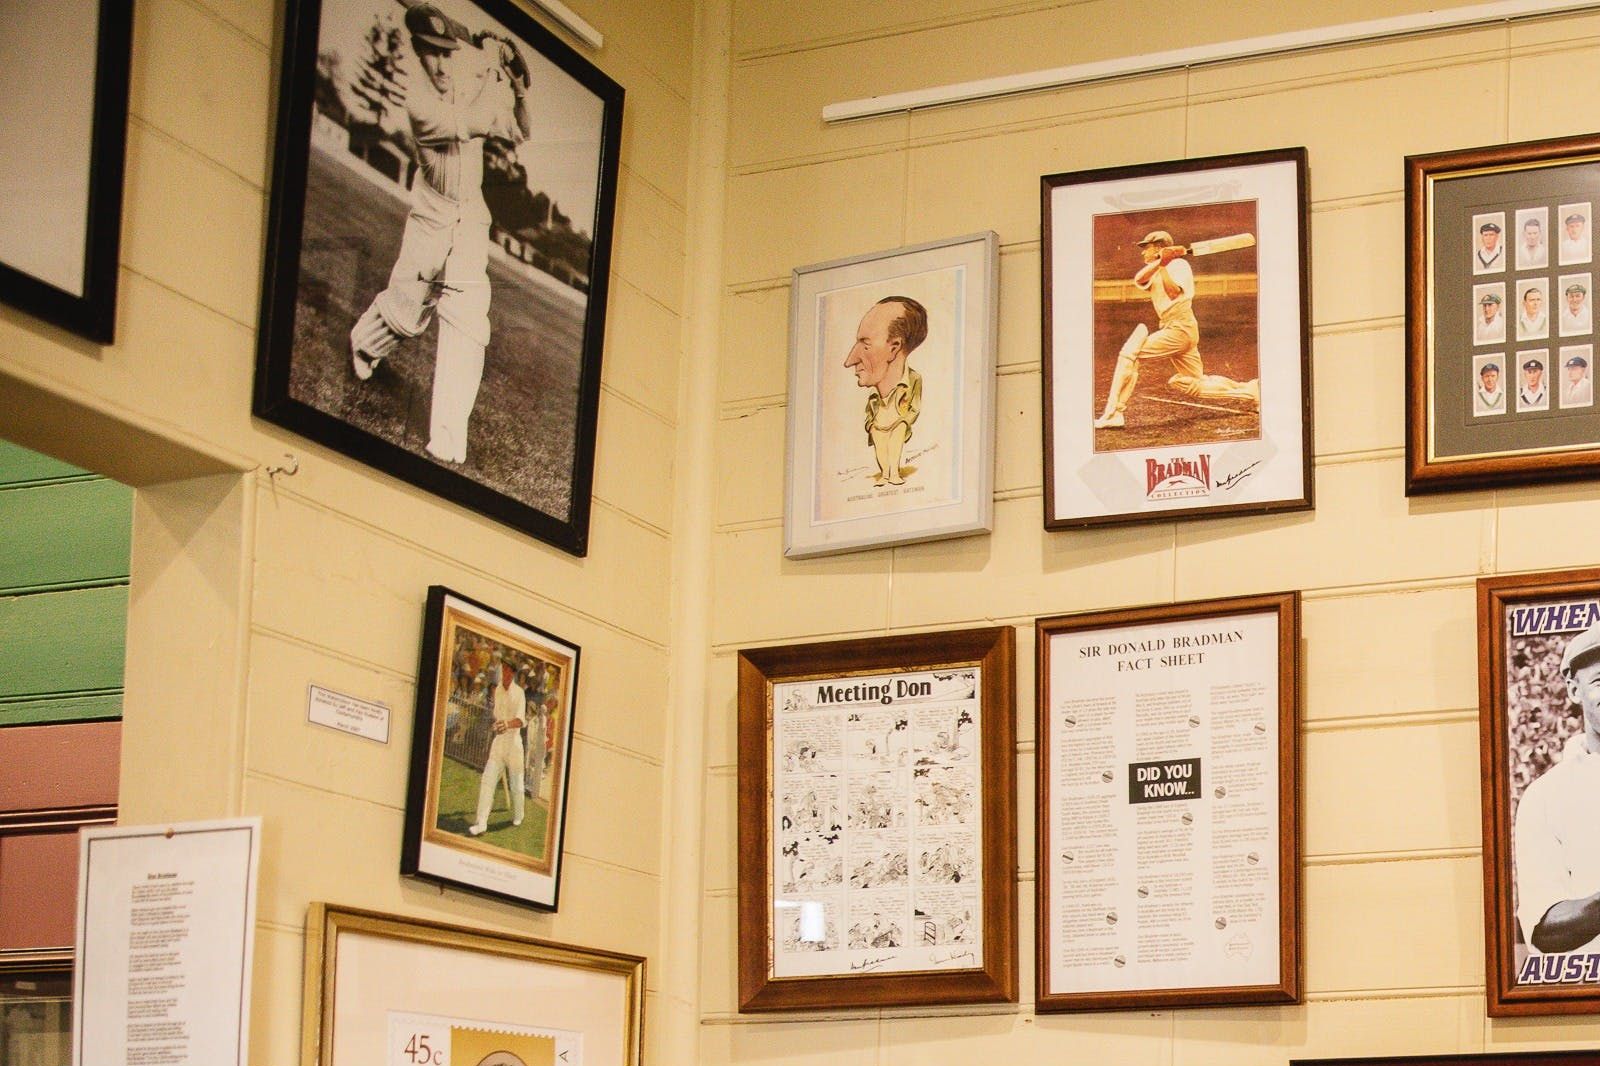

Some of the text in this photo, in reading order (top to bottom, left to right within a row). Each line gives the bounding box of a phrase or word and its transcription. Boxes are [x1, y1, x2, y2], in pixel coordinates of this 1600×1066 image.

[1145, 454, 1211, 496] BRADMAN
[1079, 630, 1244, 659] SIR DONALD BRADMAN
[1117, 652, 1205, 672] FACT SHEET
[816, 678, 932, 705] Meeting Don
[1136, 763, 1193, 782] DID YOU
[1143, 781, 1195, 799] KNOW...
[403, 1032, 443, 1066] 45c
